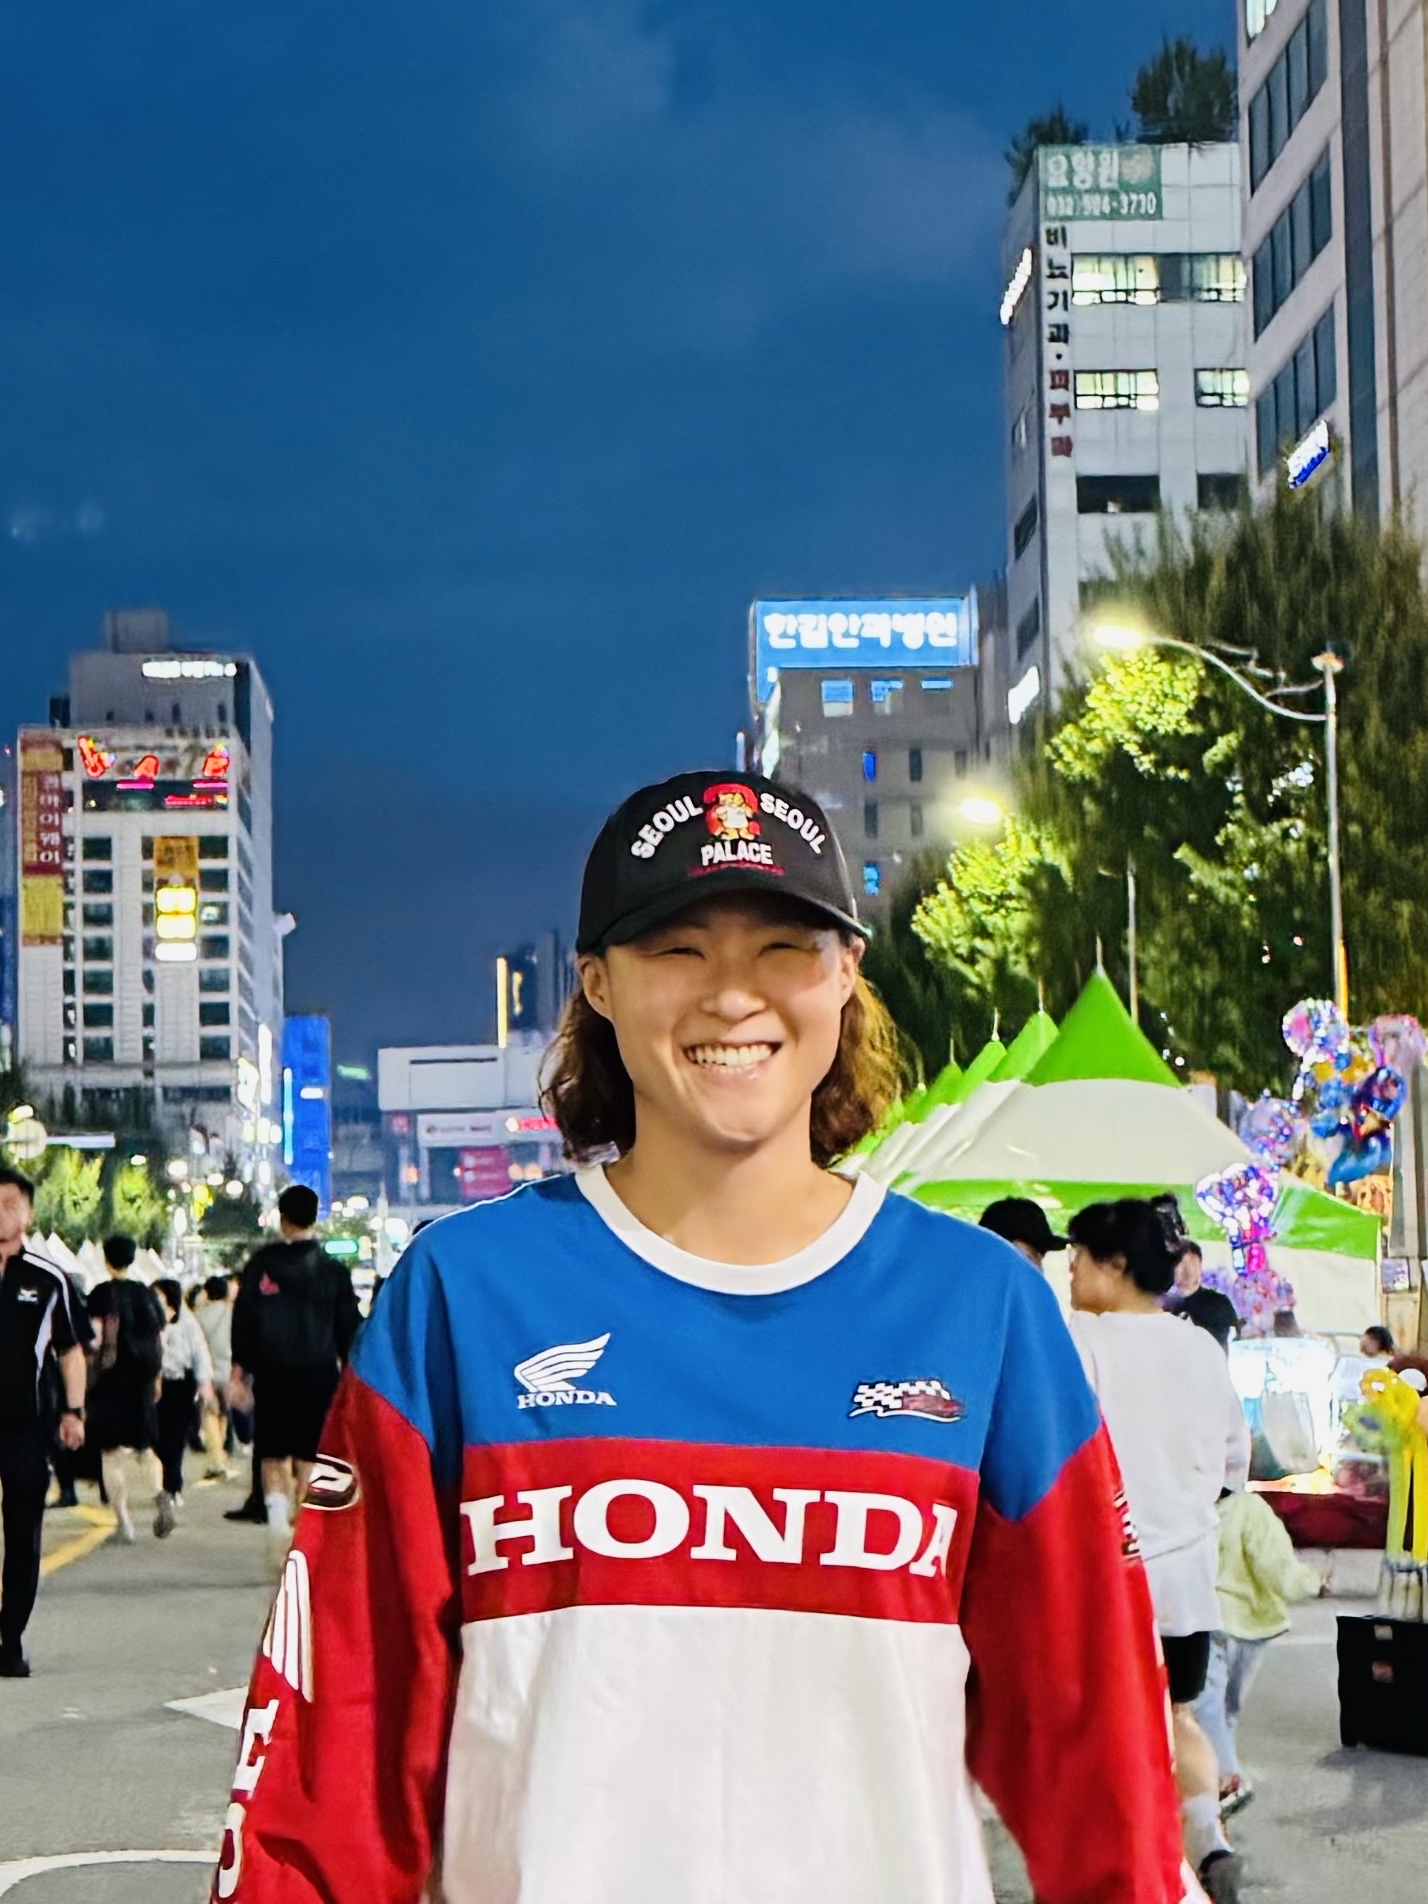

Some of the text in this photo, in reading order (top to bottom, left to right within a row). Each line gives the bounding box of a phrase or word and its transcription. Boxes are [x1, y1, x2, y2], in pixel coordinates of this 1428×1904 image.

[631, 792, 827, 859] SEOUL SEOUL
[700, 840, 774, 867] PALACE
[517, 1389, 618, 1410] HONDA
[459, 1478, 958, 1578] HONDA
